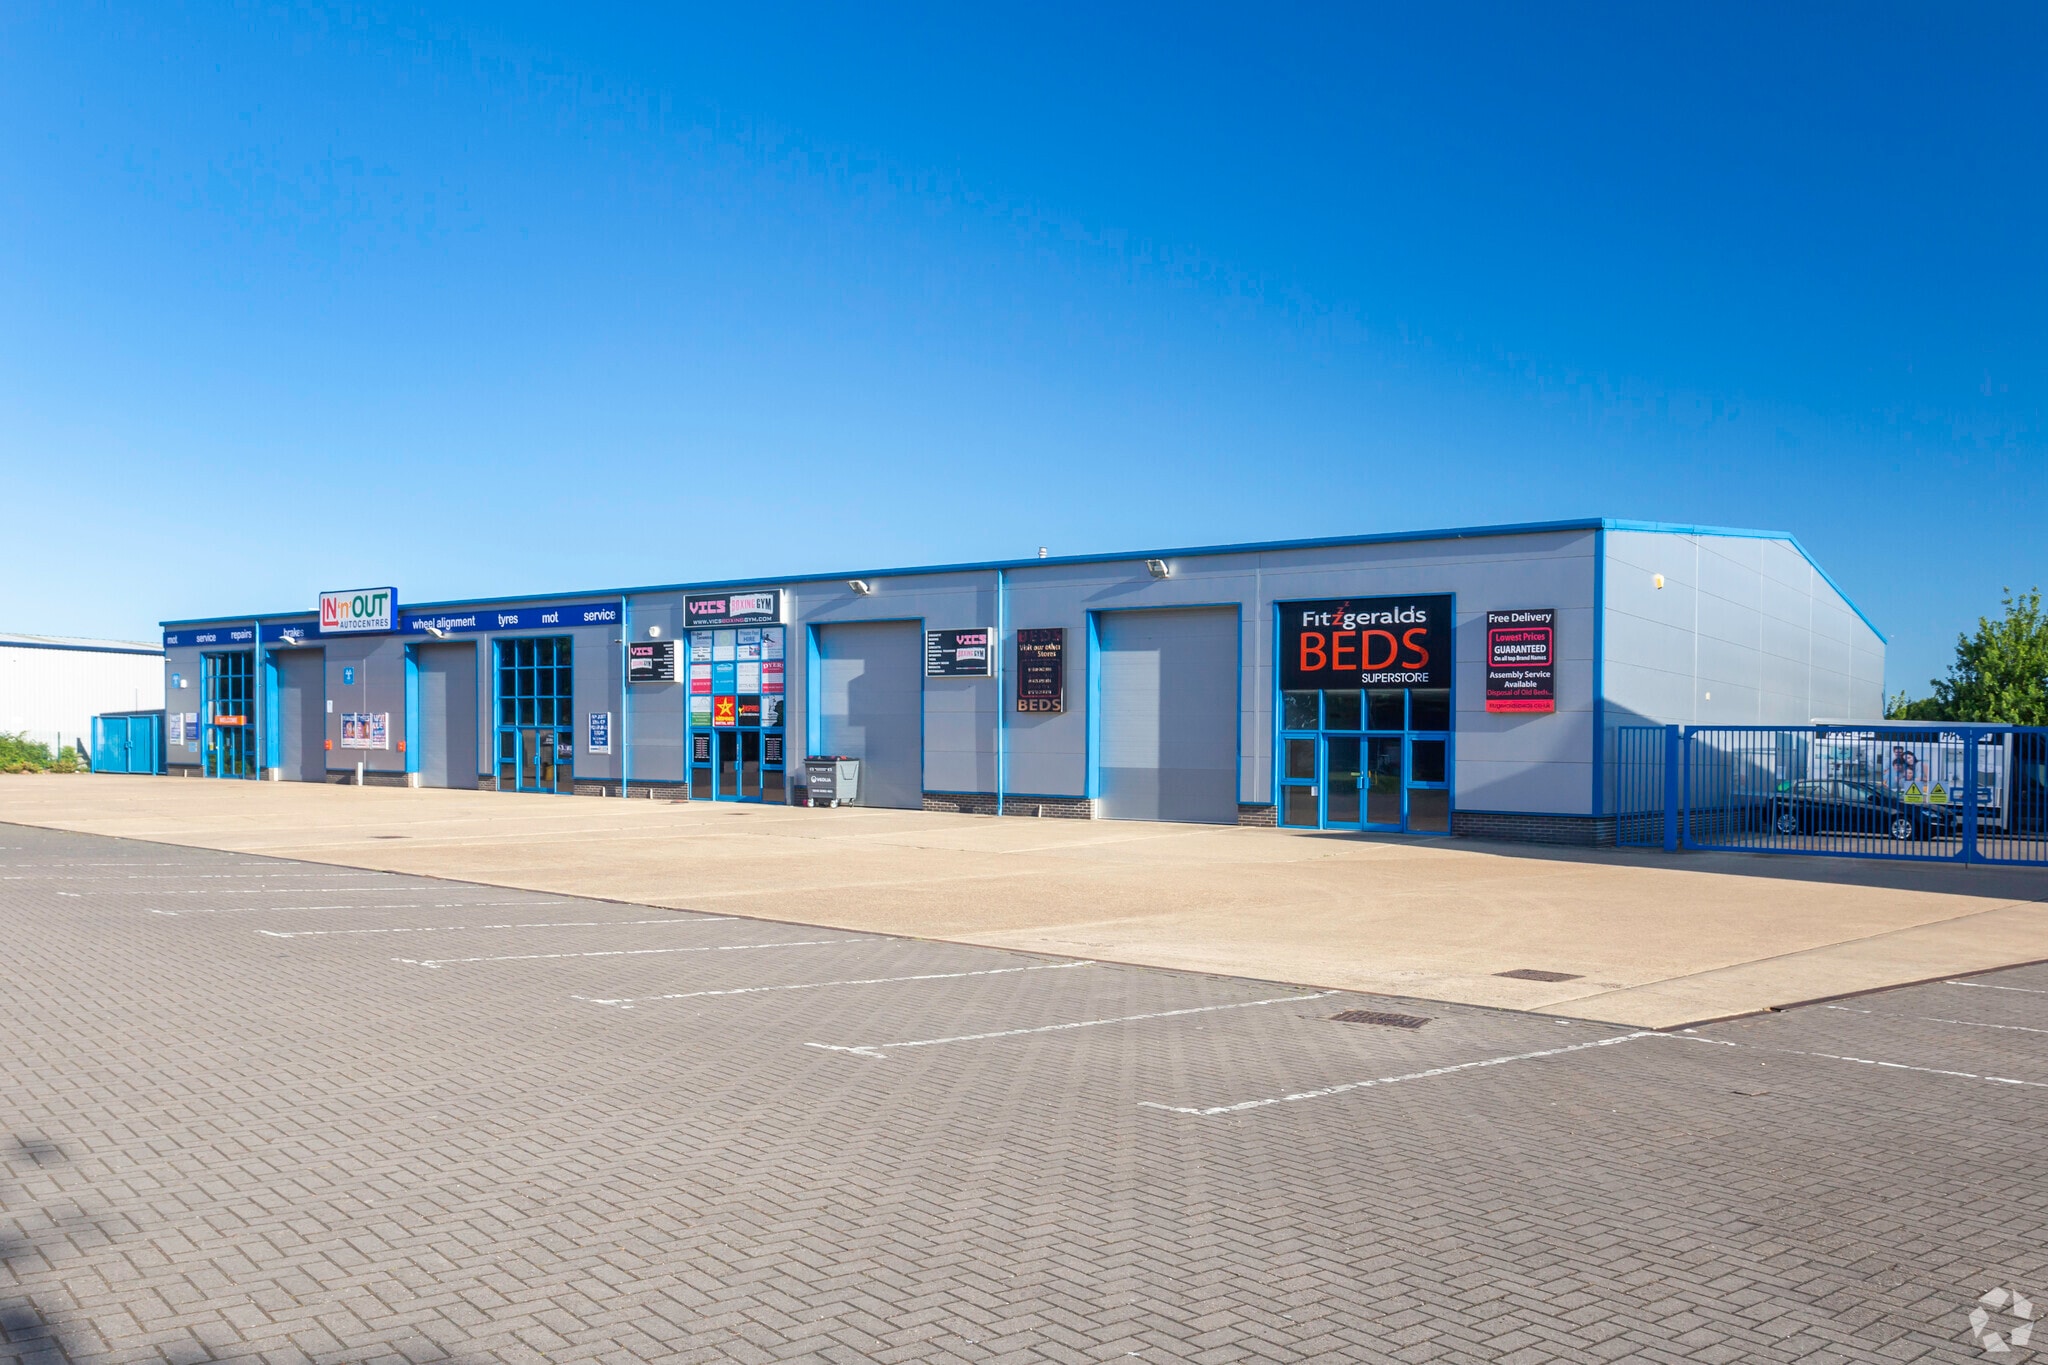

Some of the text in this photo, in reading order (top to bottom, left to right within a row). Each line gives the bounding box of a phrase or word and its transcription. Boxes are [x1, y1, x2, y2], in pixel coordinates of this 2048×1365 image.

[689, 598, 772, 614] VICS BOXING GYM
[498, 613, 519, 628] tyres
[541, 611, 559, 624] mot
[583, 608, 616, 622] service
[1489, 612, 1552, 624] Free Delivery
[340, 618, 389, 629] AUTOCENTRES
[412, 615, 476, 630] wheel alignment
[196, 632, 217, 643] service
[230, 629, 252, 641] repairs
[283, 626, 304, 638] brakes
[1495, 632, 1546, 642] Lowest Prices
[167, 634, 178, 644] mot
[956, 634, 987, 645] VICS
[631, 647, 653, 656] VICS
[1300, 628, 1430, 672] BEDS
[1494, 644, 1547, 654] GUARANTEED
[1361, 672, 1429, 684] SUPERSTORE
[1490, 670, 1551, 680] Assembly Service
[1504, 680, 1538, 688] Available
[1018, 698, 1062, 712] BEDS
